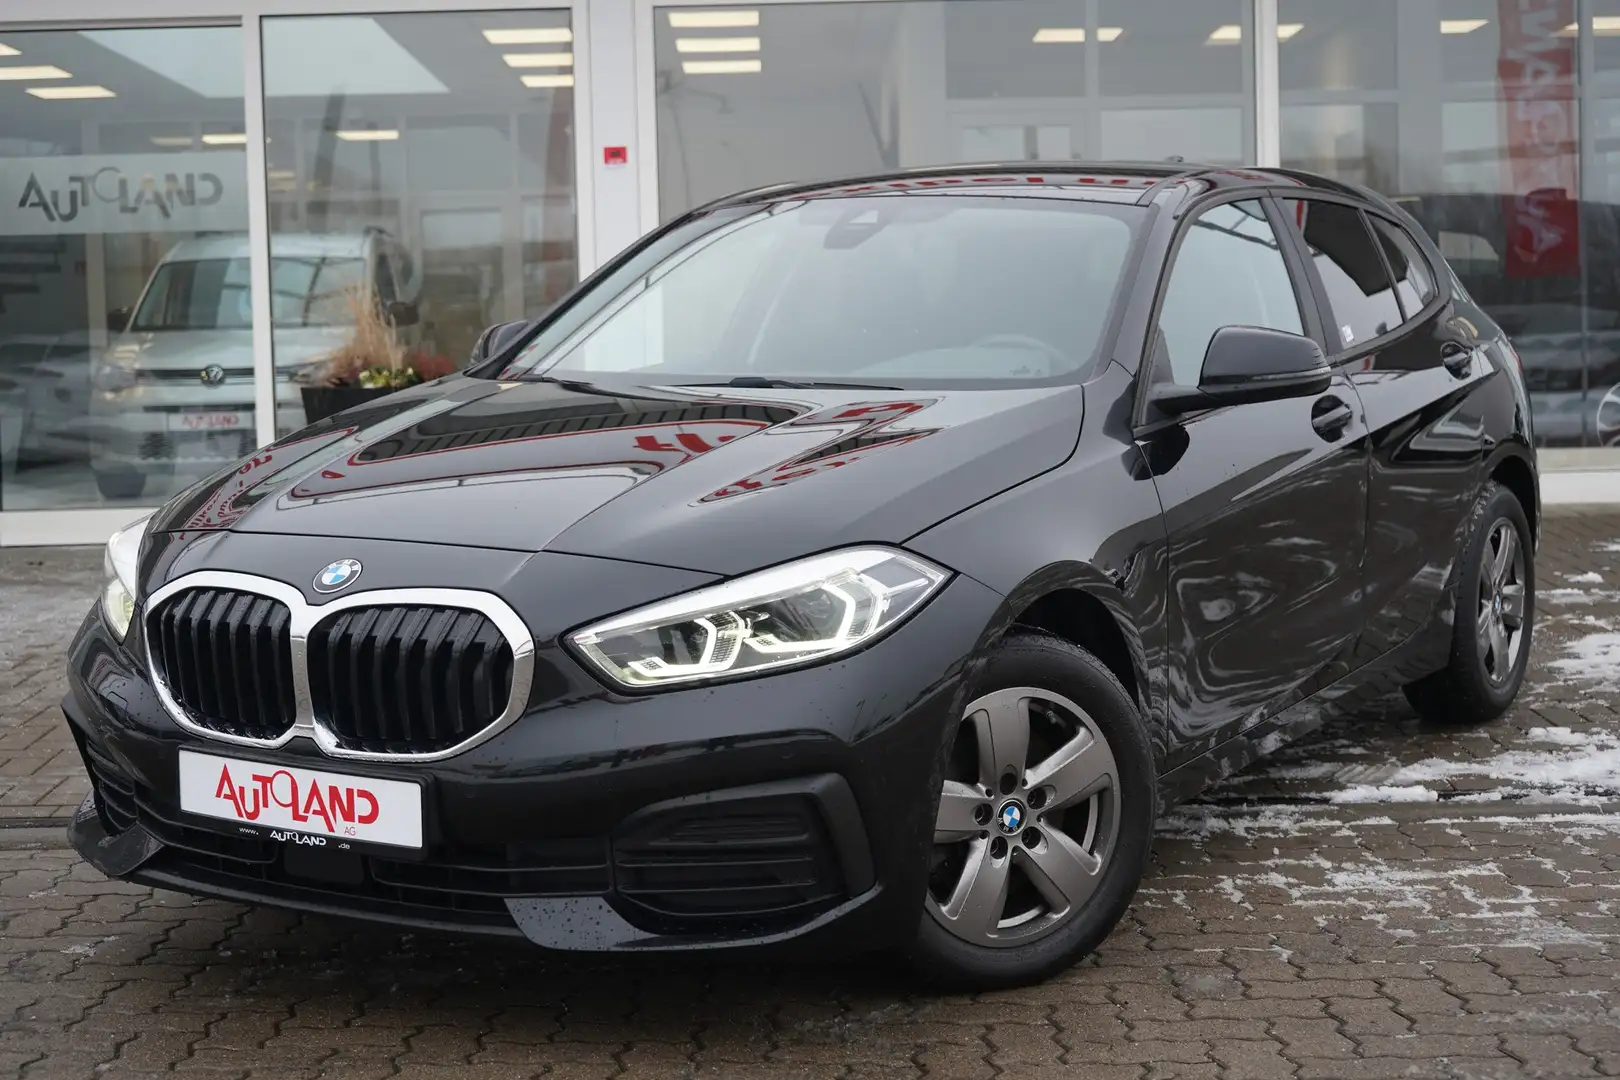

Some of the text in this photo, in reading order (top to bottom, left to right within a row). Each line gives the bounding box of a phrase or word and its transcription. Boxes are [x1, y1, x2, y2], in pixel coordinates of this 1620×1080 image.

[18, 166, 224, 222] AUTOLAND
[215, 763, 379, 833] AUTOLAND
[270, 830, 327, 847] AUTOLAND
[338, 842, 350, 850] .de
[344, 826, 356, 837] AG
